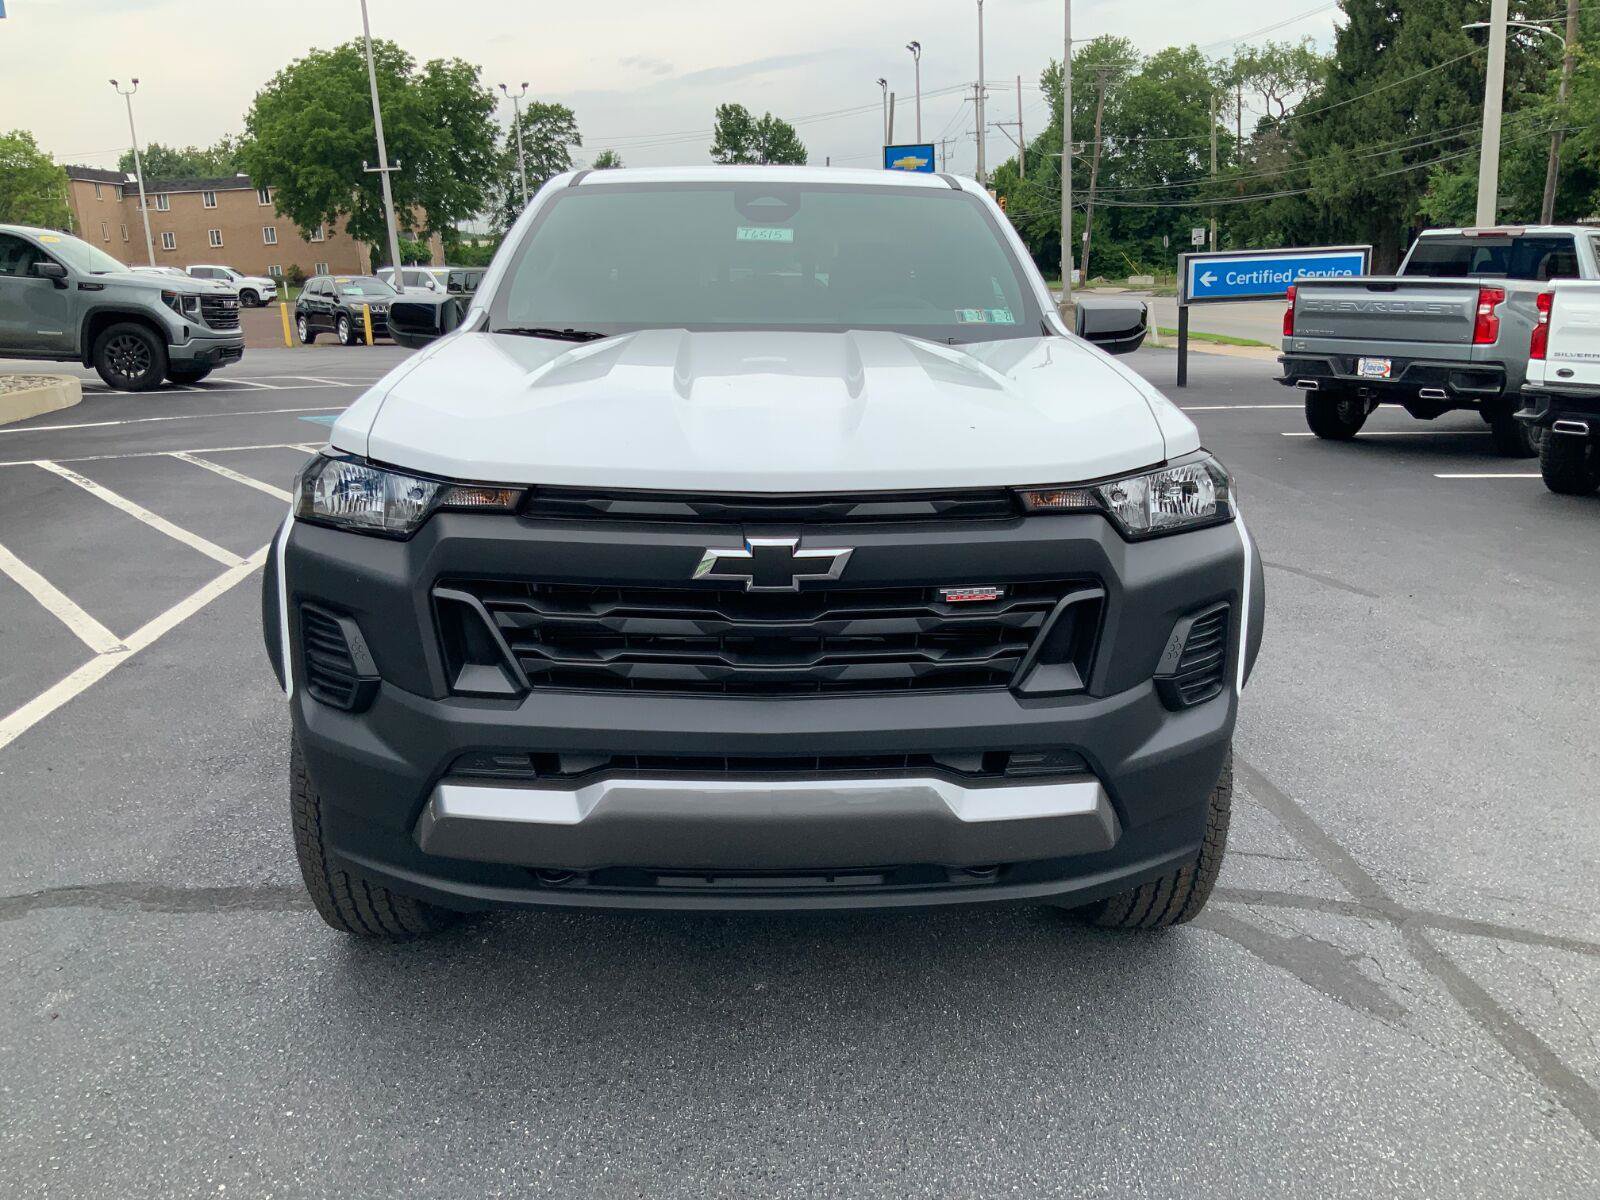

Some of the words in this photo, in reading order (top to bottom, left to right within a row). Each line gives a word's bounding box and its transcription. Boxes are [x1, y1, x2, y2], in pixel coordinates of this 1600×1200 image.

[1226, 268, 1292, 285] Certified
[1297, 267, 1352, 277] Service
[1304, 301, 1462, 313] CHEVROLET
